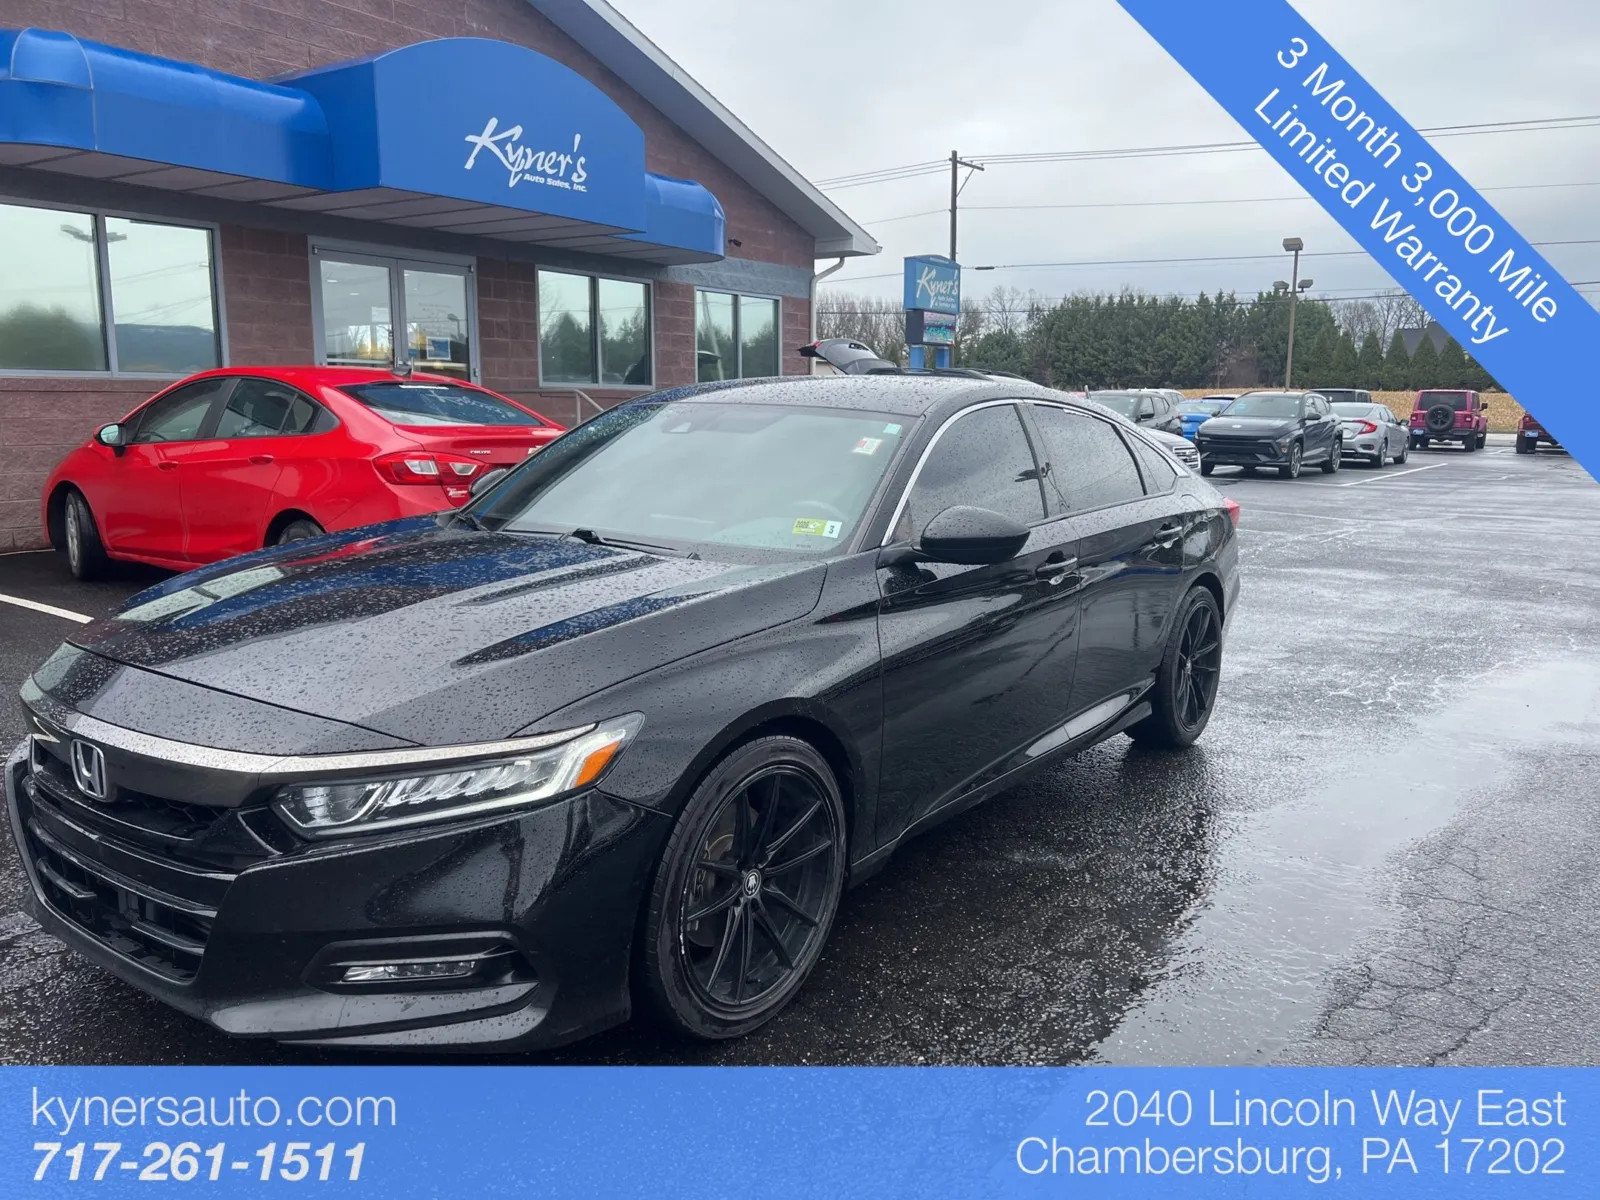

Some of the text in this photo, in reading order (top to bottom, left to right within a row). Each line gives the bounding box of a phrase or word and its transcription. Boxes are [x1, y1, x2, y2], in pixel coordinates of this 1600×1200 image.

[464, 117, 587, 188] Kyner's
[523, 173, 588, 192] Auto Sales, Inc.
[916, 266, 959, 308] Kyner's
[828, 525, 835, 534] 3
